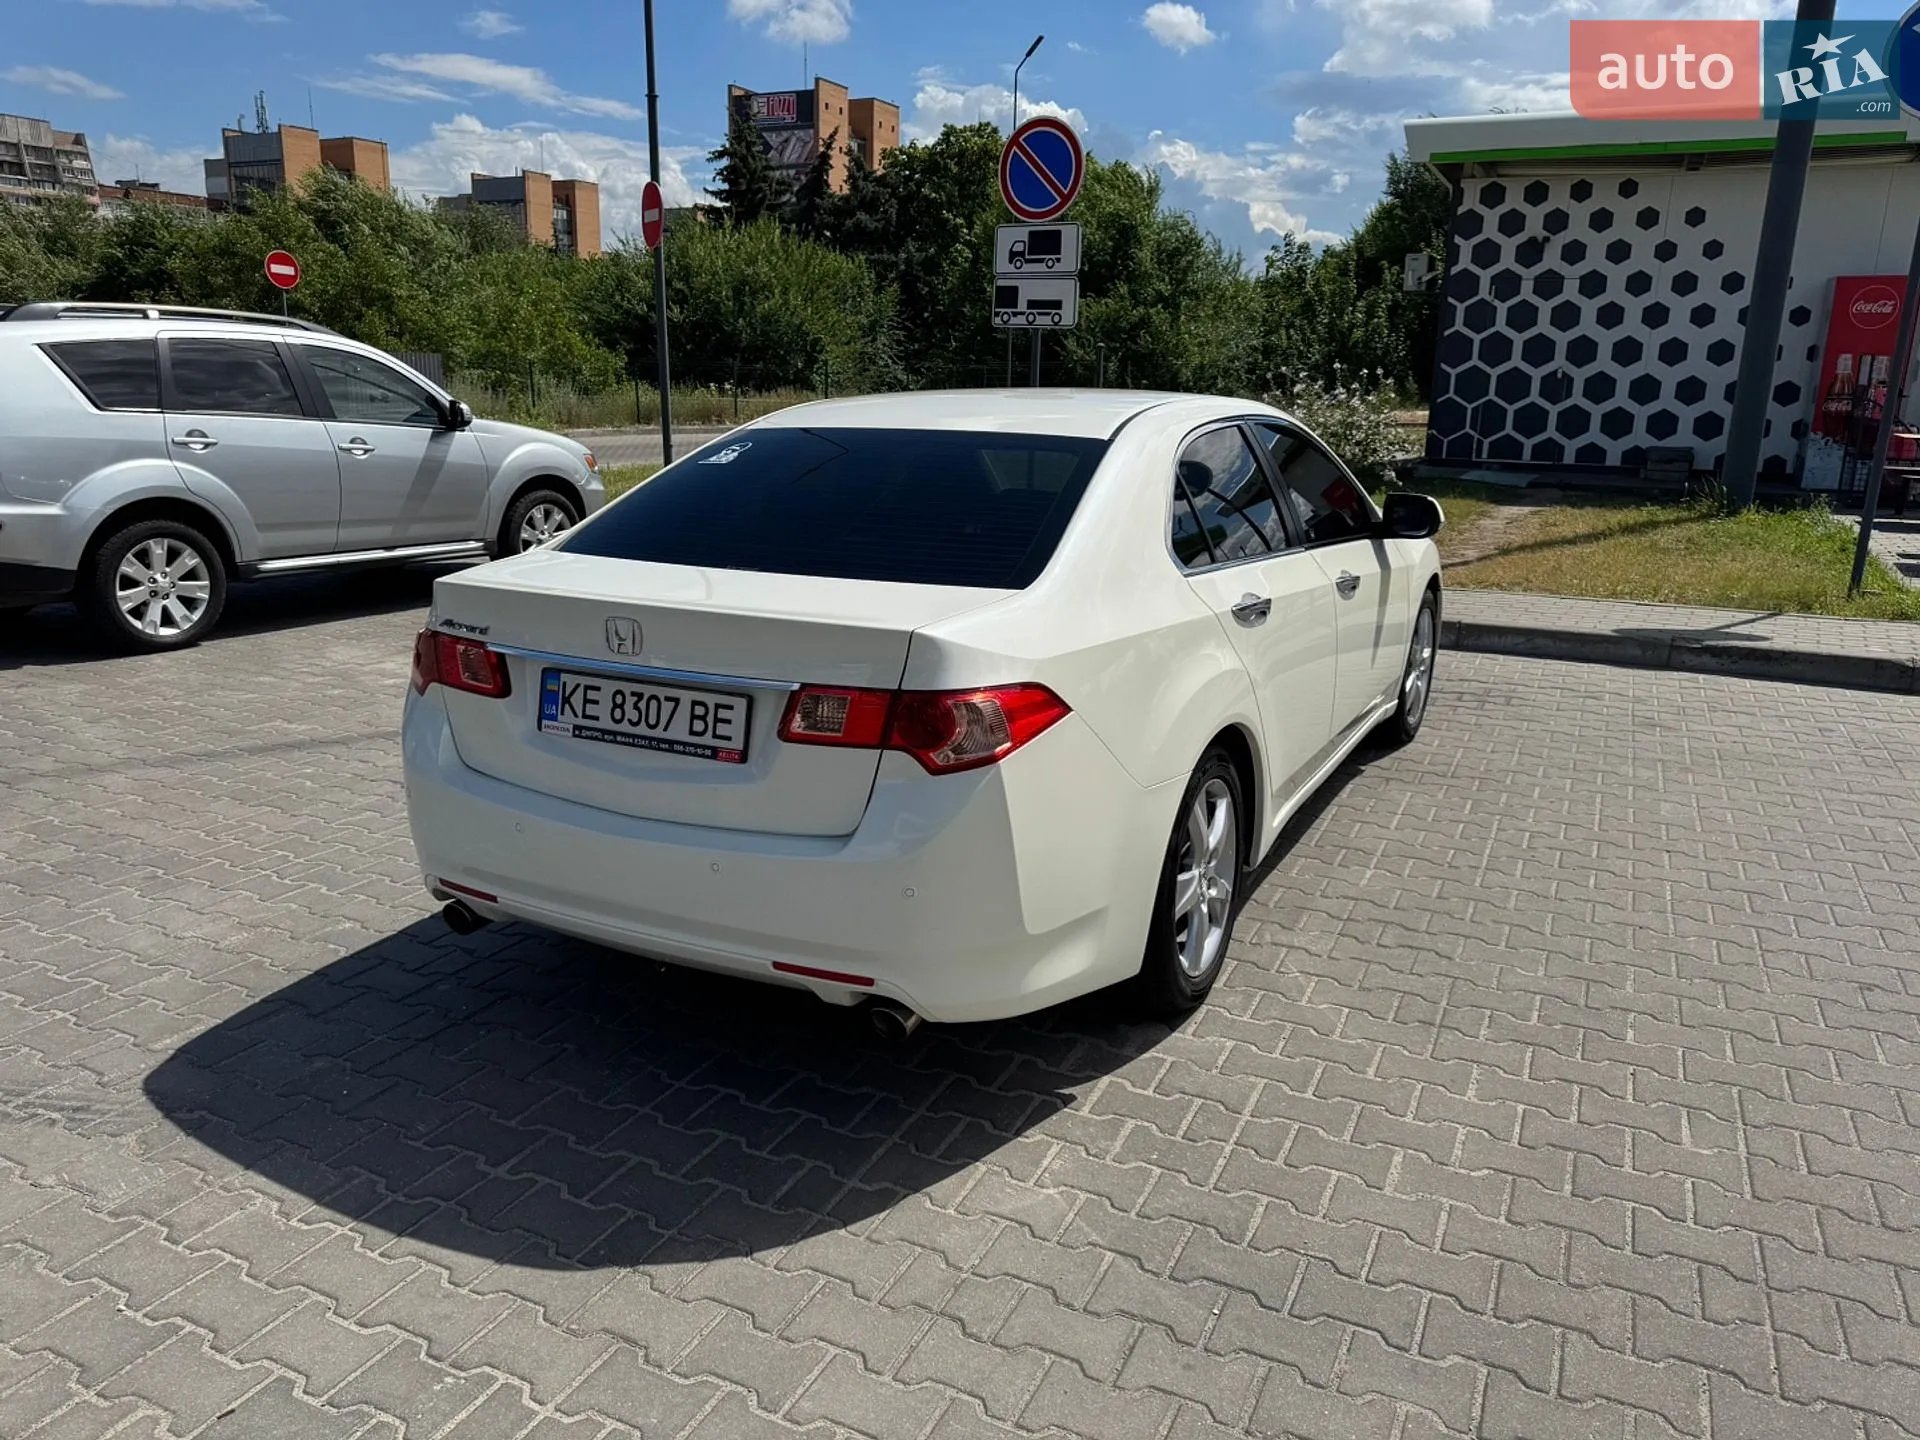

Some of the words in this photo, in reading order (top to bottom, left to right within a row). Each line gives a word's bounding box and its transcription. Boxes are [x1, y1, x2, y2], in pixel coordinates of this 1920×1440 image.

[1852, 300, 1896, 314] Coca-Cola
[543, 703, 558, 716] UA
[559, 680, 602, 722] KE
[609, 689, 681, 734] 8307
[688, 699, 735, 742] BE
